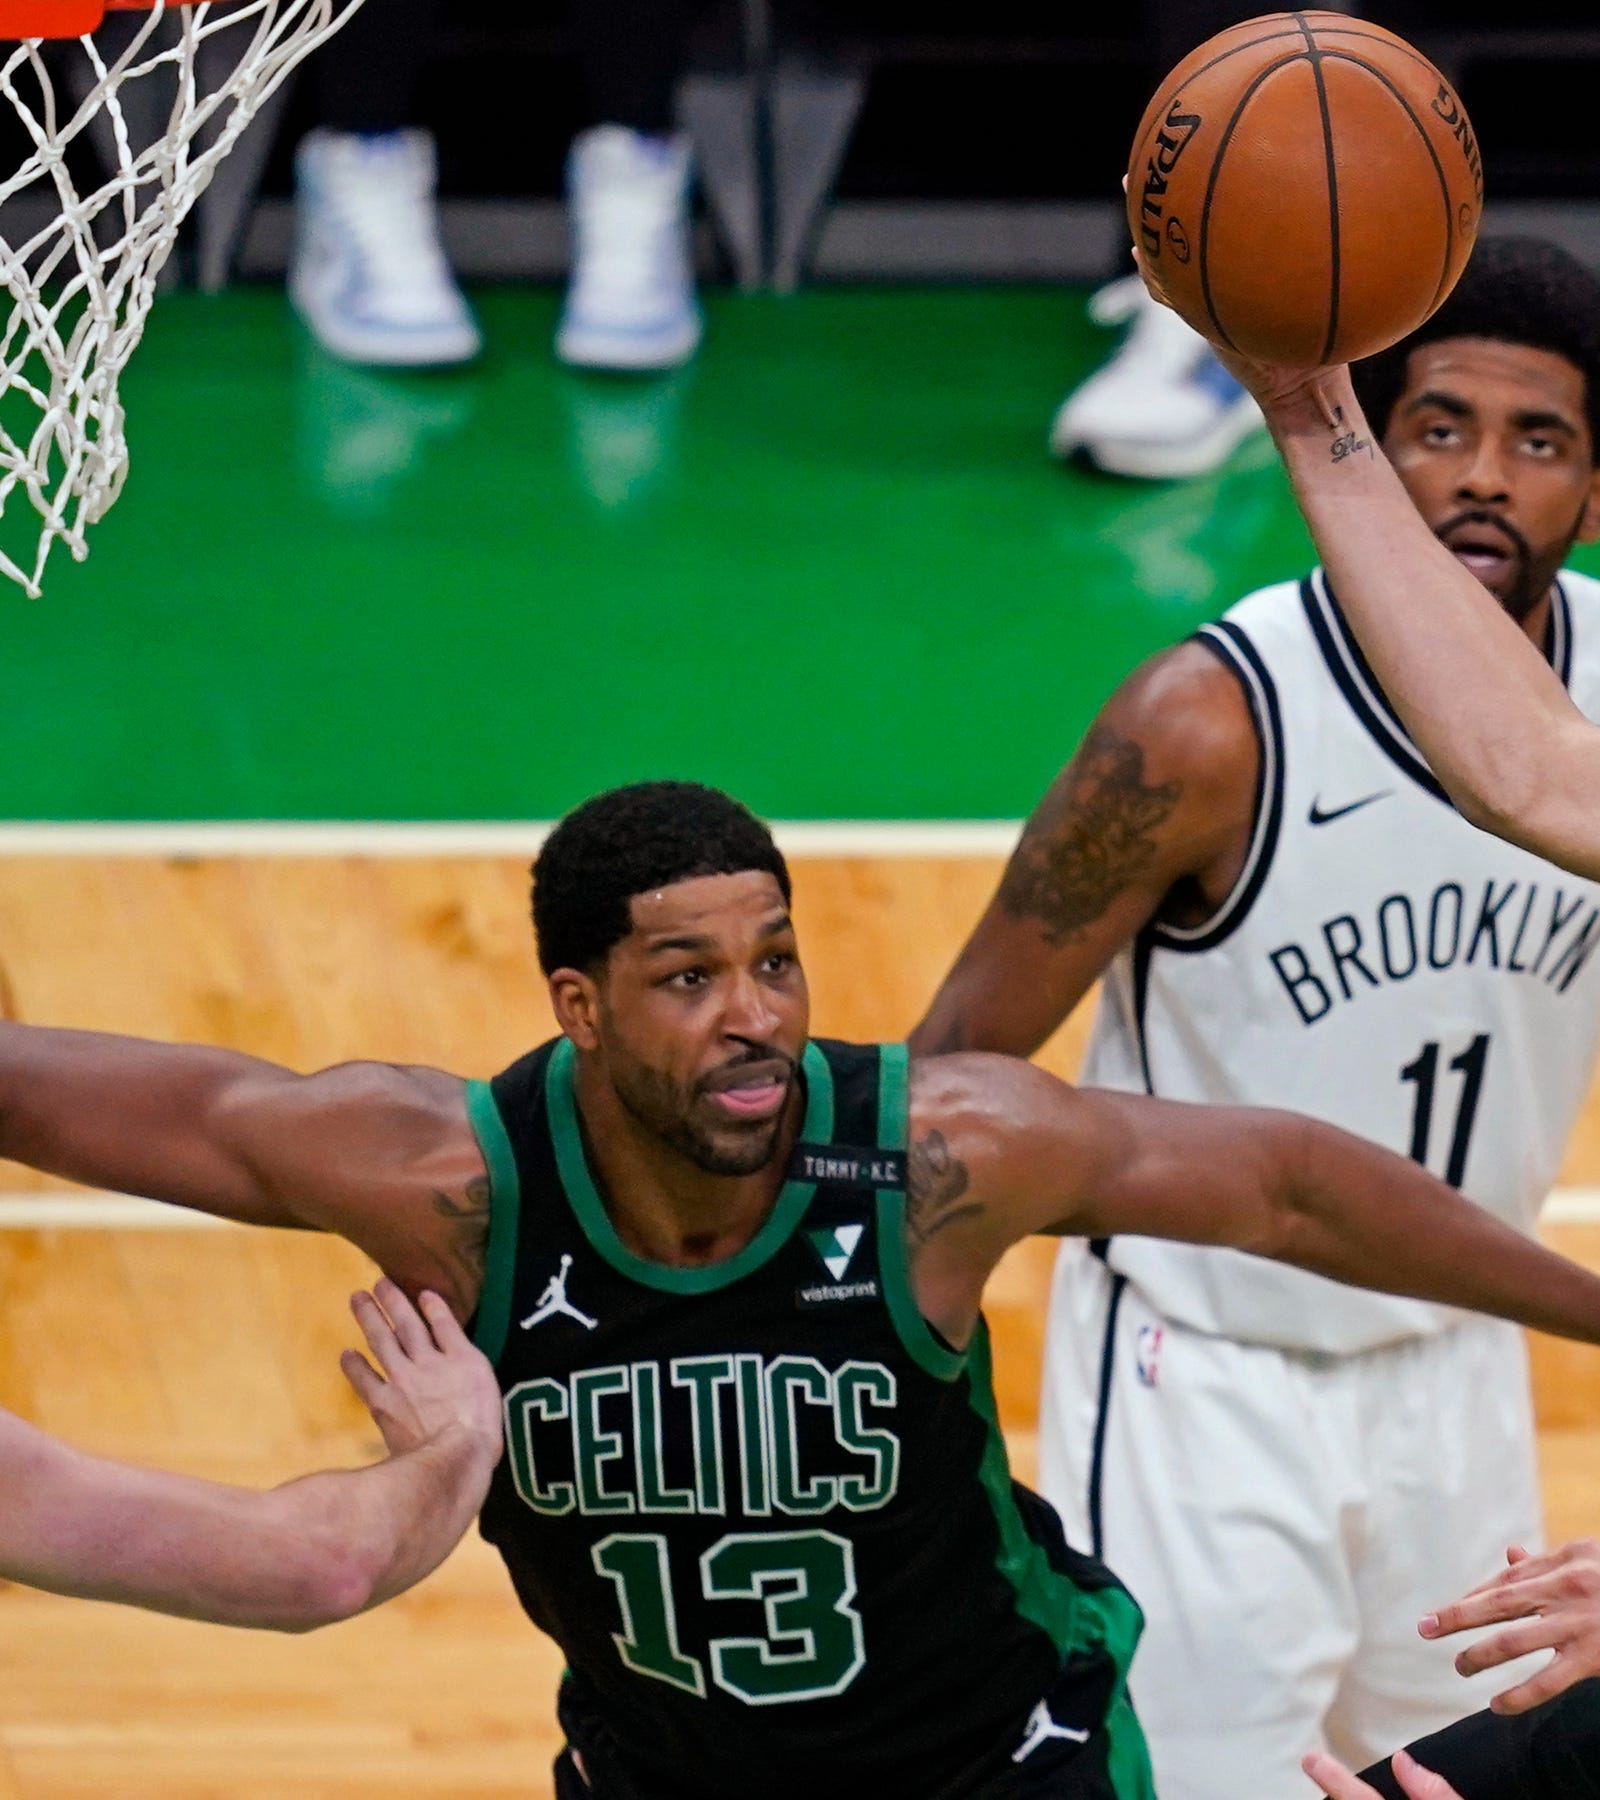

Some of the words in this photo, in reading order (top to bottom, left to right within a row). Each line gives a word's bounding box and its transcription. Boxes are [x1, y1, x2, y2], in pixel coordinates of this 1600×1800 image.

[803, 1155, 860, 1182] TOMMY
[1400, 1033, 1491, 1189] 11
[801, 1281, 877, 1302] vistaprint
[502, 1354, 900, 1517] CELTICS
[591, 1529, 866, 1706] 13
